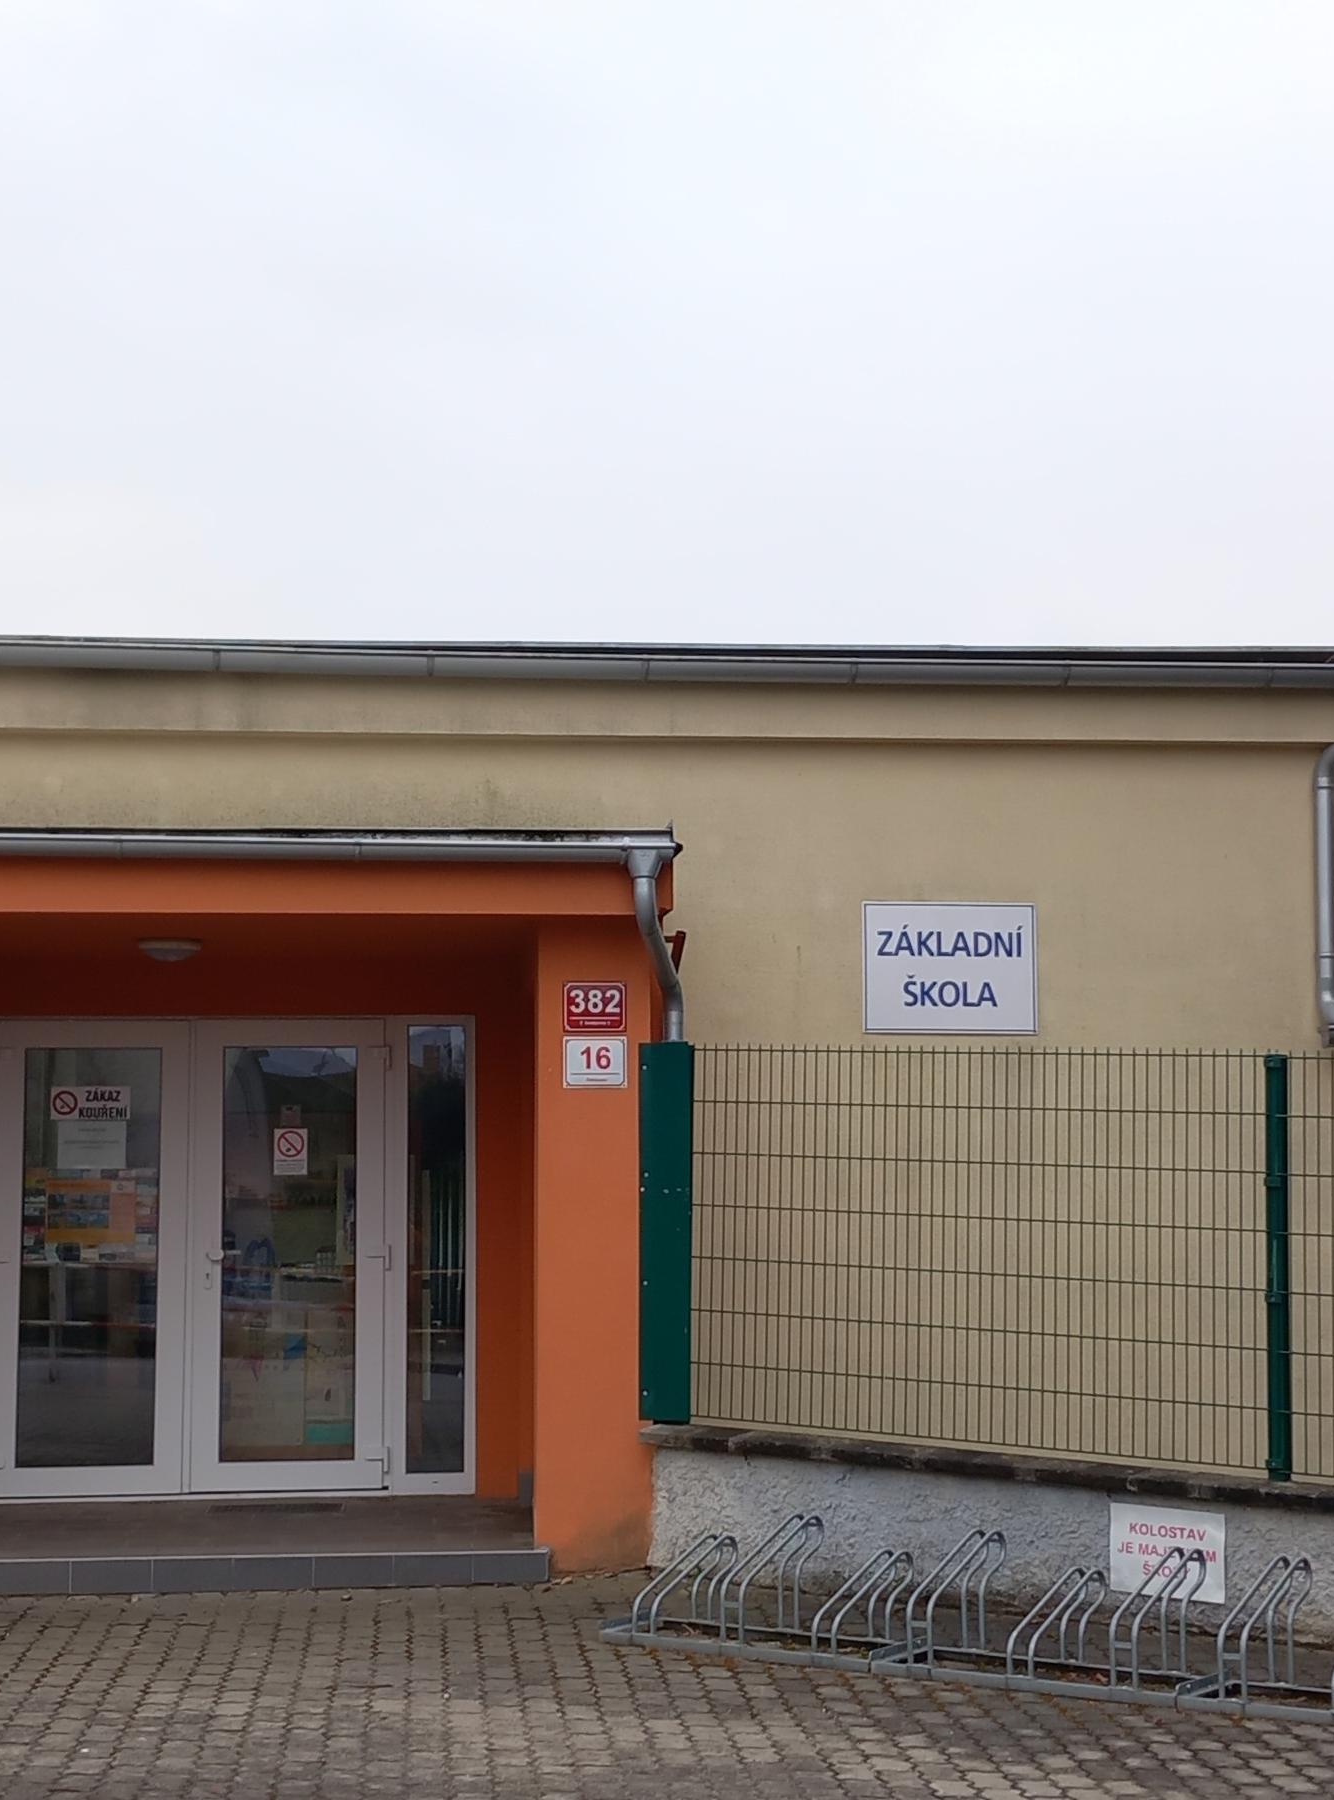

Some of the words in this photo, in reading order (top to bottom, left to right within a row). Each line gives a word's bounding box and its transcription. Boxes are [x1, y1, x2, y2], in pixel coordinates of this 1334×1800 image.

[876, 924, 1024, 958] ZÁKLADNÍ
[569, 989, 621, 1014] 382
[903, 974, 998, 1008] ŠKOLA
[580, 1046, 611, 1070] 16
[85, 1088, 122, 1102] ZÁKAZ
[78, 1104, 128, 1119] KOUŘENÍ
[1129, 1522, 1207, 1541] KOLOSTAV
[1118, 1541, 1134, 1554] JE
